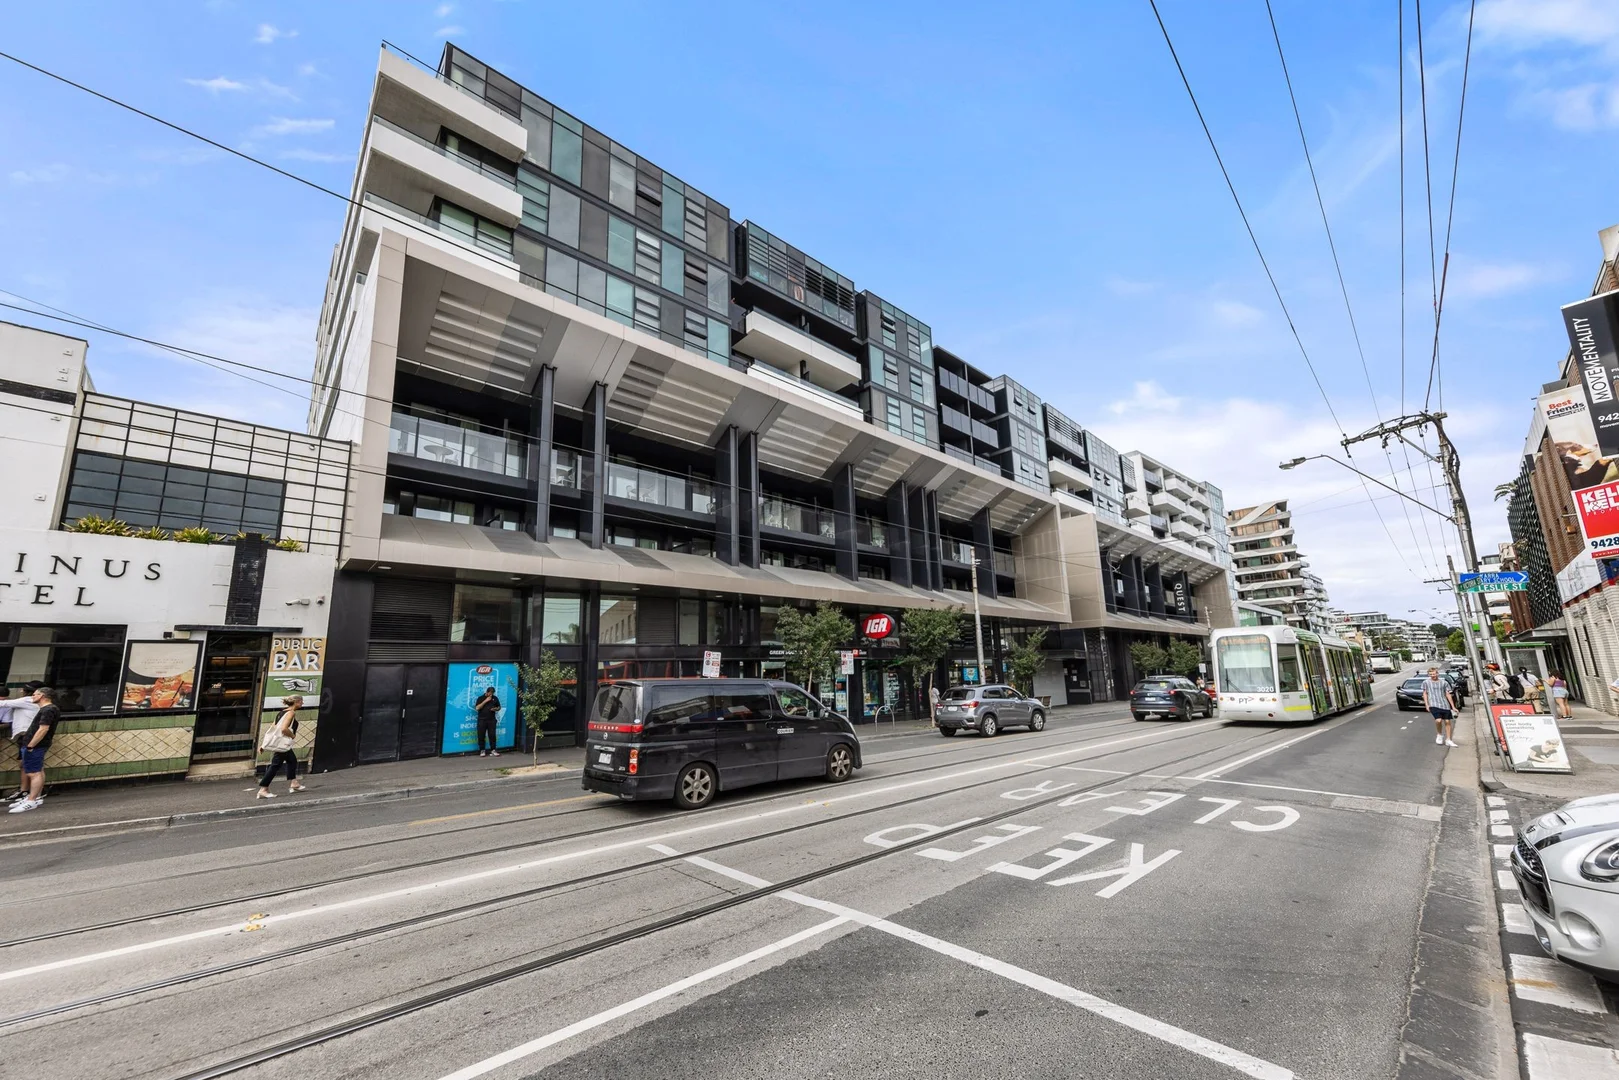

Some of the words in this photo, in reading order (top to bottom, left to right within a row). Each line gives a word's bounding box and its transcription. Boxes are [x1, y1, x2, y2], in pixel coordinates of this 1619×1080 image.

[1572, 318, 1610, 400] MOVEMENTALITY
[1546, 402, 1585, 416] Friends
[1548, 399, 1573, 410] Best
[1591, 536, 1619, 549] 9428
[15, 553, 161, 580] INUS
[1478, 583, 1510, 592] LESLIE
[1512, 582, 1523, 591] ST
[1174, 583, 1186, 612] QUEST
[865, 617, 888, 634] IGA
[272, 638, 323, 651] PUBLIC
[273, 651, 319, 671] BAR
[1000, 780, 1301, 832] CLEAR
[863, 817, 1182, 899] KEEP
